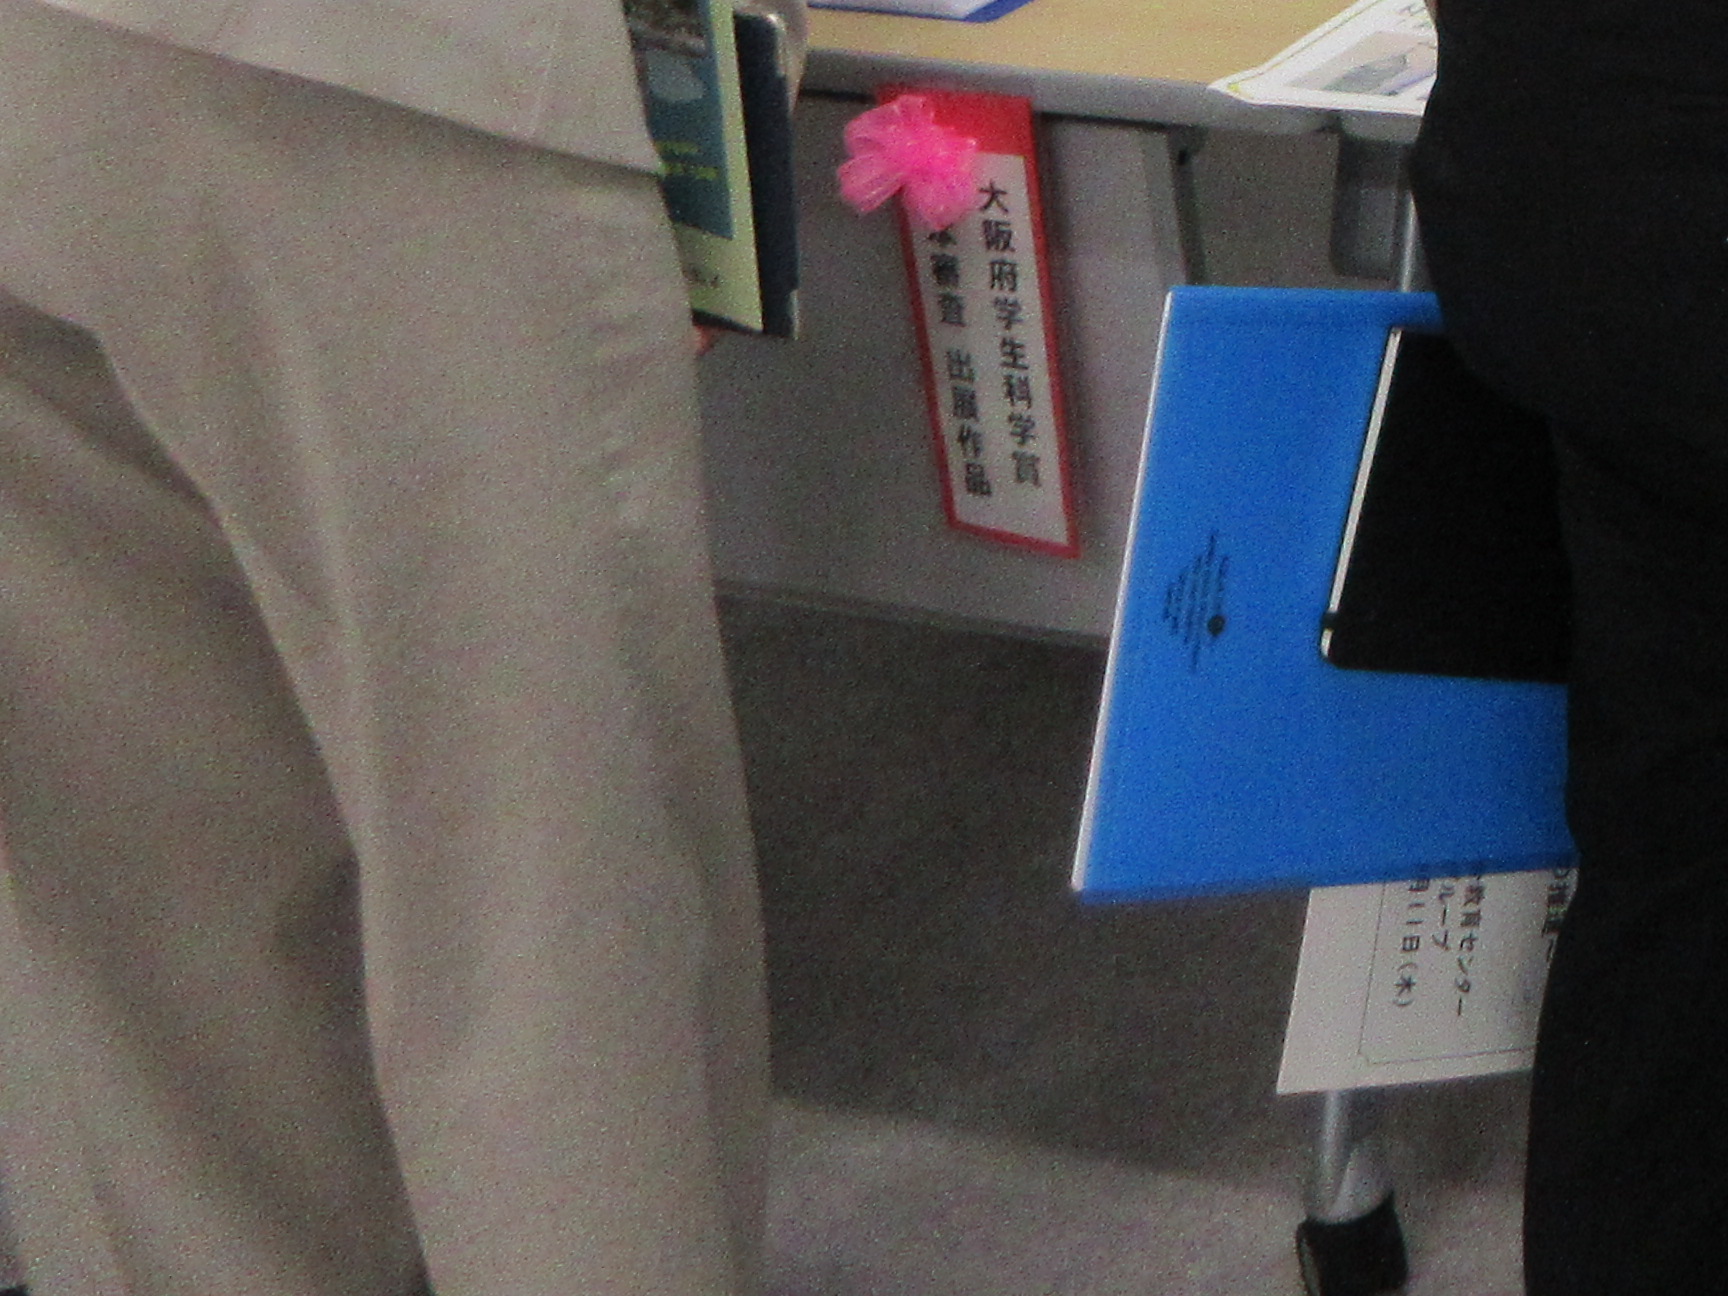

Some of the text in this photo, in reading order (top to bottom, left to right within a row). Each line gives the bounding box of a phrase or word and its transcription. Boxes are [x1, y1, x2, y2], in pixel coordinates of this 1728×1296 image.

[978, 180, 1042, 489] 大阪府学生科学賞
